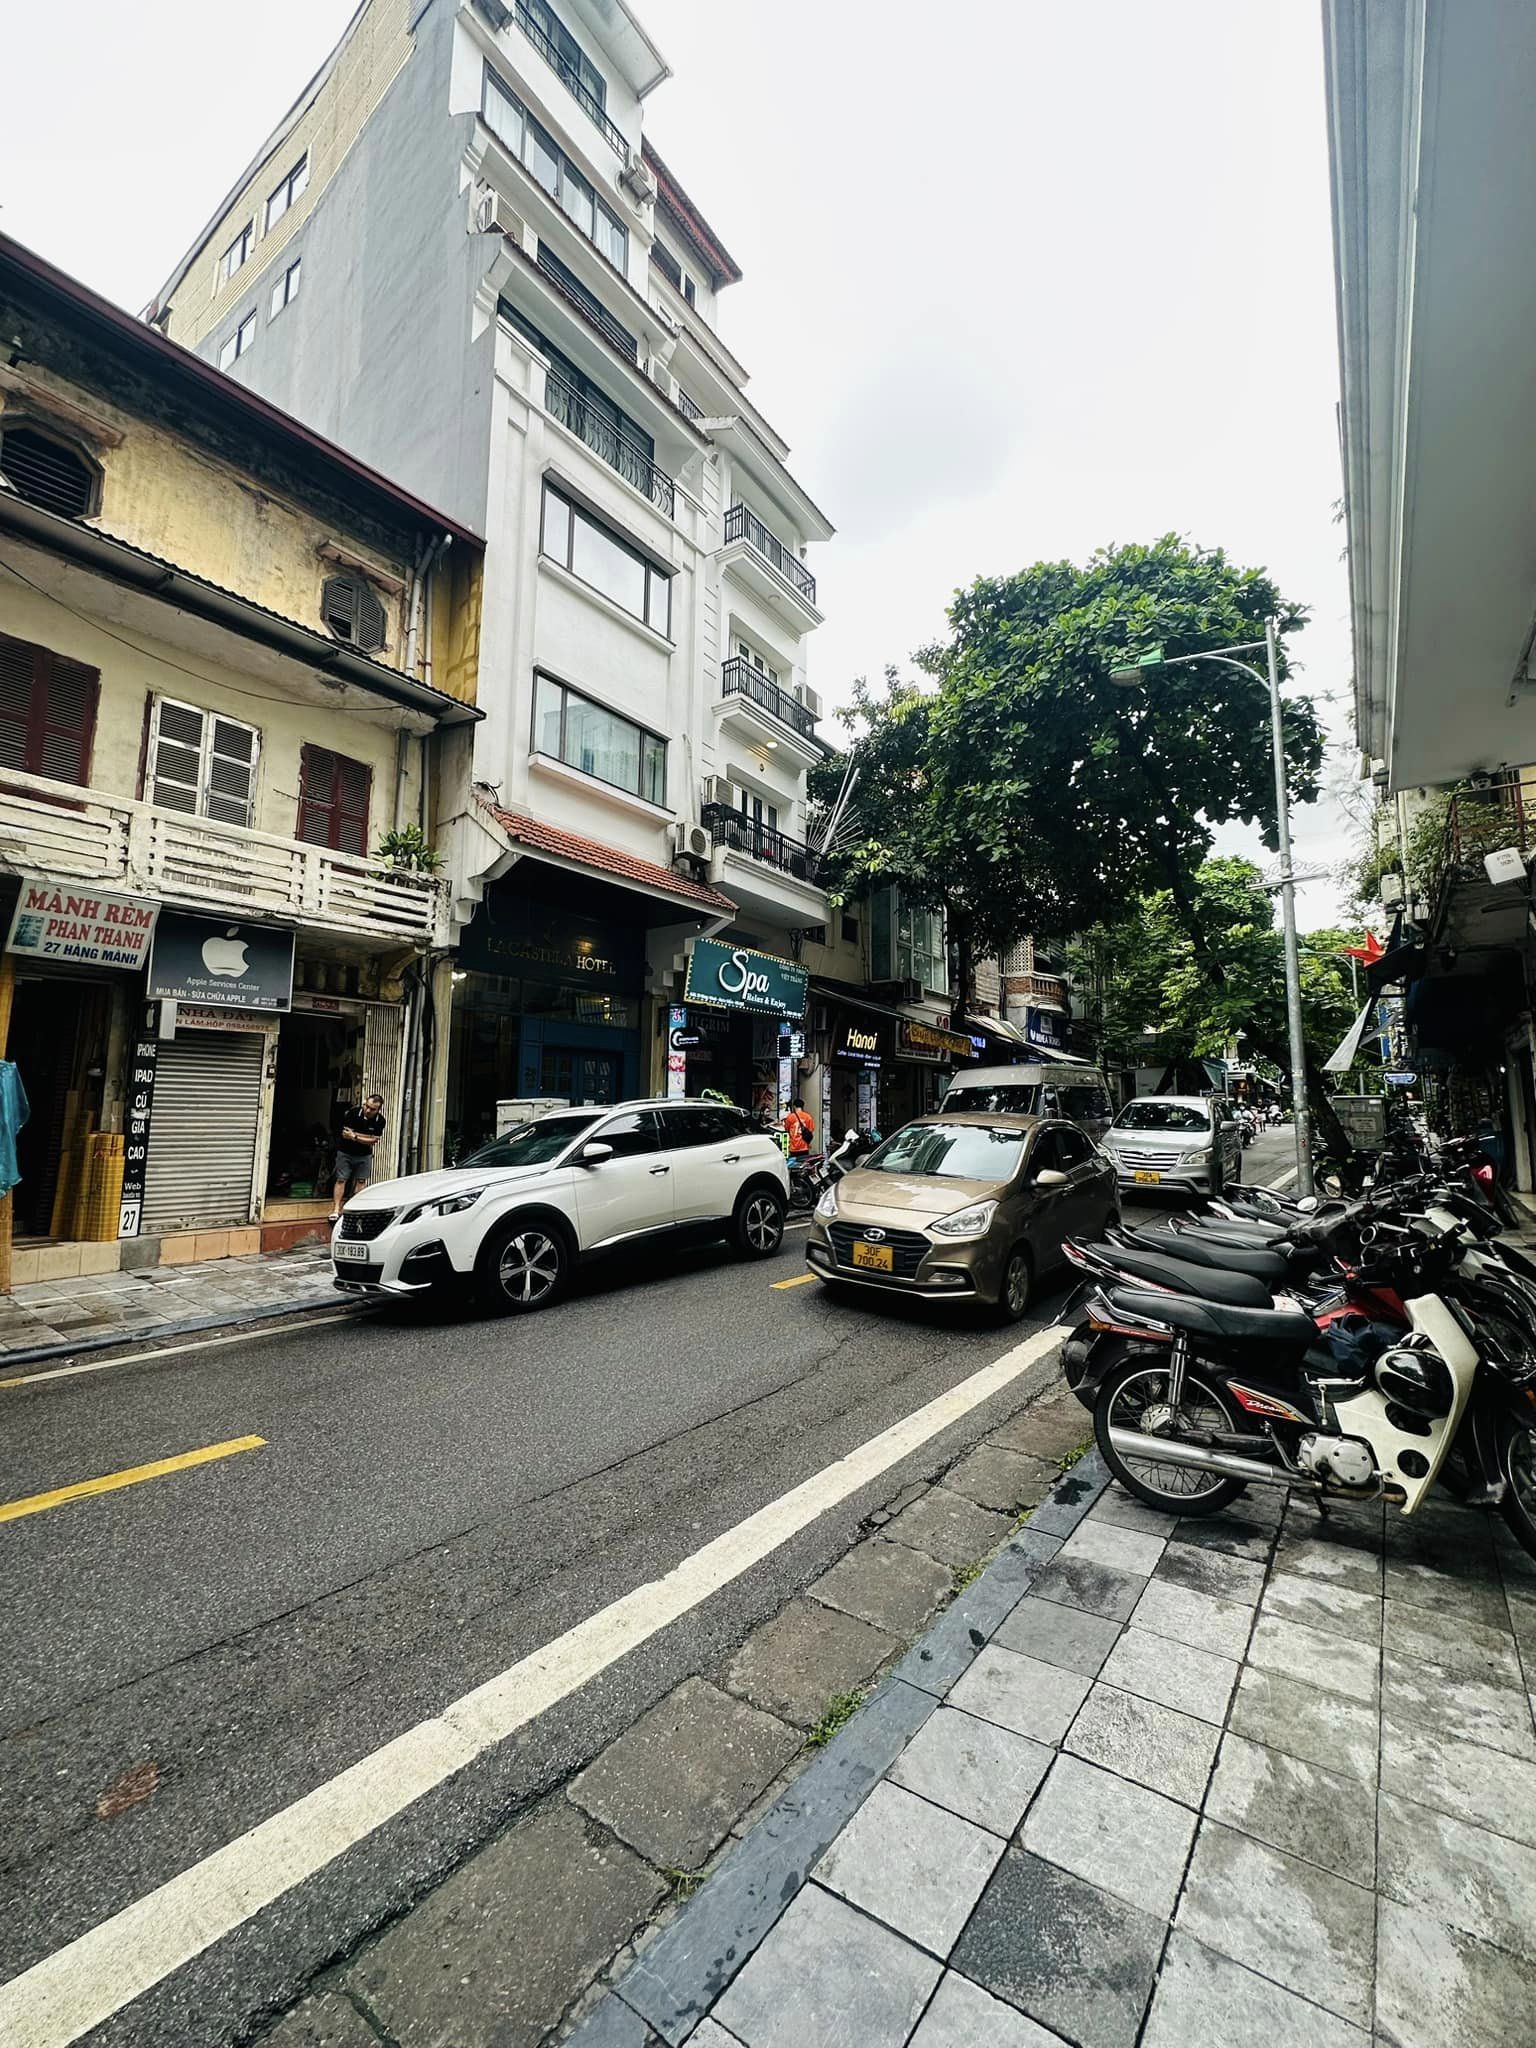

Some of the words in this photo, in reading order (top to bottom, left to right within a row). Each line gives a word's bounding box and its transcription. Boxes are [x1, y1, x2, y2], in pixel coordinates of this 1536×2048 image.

[25, 888, 102, 919] MÀNH
[45, 919, 91, 941] PHAN
[95, 926, 145, 949] THANH
[43, 942, 61, 954] 27
[576, 955, 616, 975] HOTEL
[719, 951, 770, 1000] Spa
[186, 977, 207, 987] Apple
[208, 979, 237, 989] Services
[238, 982, 260, 992] Center
[156, 987, 171, 996] MUA
[172, 986, 187, 997] BÁN
[226, 993, 246, 1003] APPLE
[770, 997, 787, 1010] Enjoy
[847, 1028, 878, 1051] Hanoi
[134, 1069, 154, 1082] IPAD
[128, 1146, 145, 1160] CAO
[124, 1182, 141, 1190] Web
[122, 1210, 136, 1231] 27
[864, 1245, 881, 1257] 30F
[857, 1255, 889, 1269] 700.24
